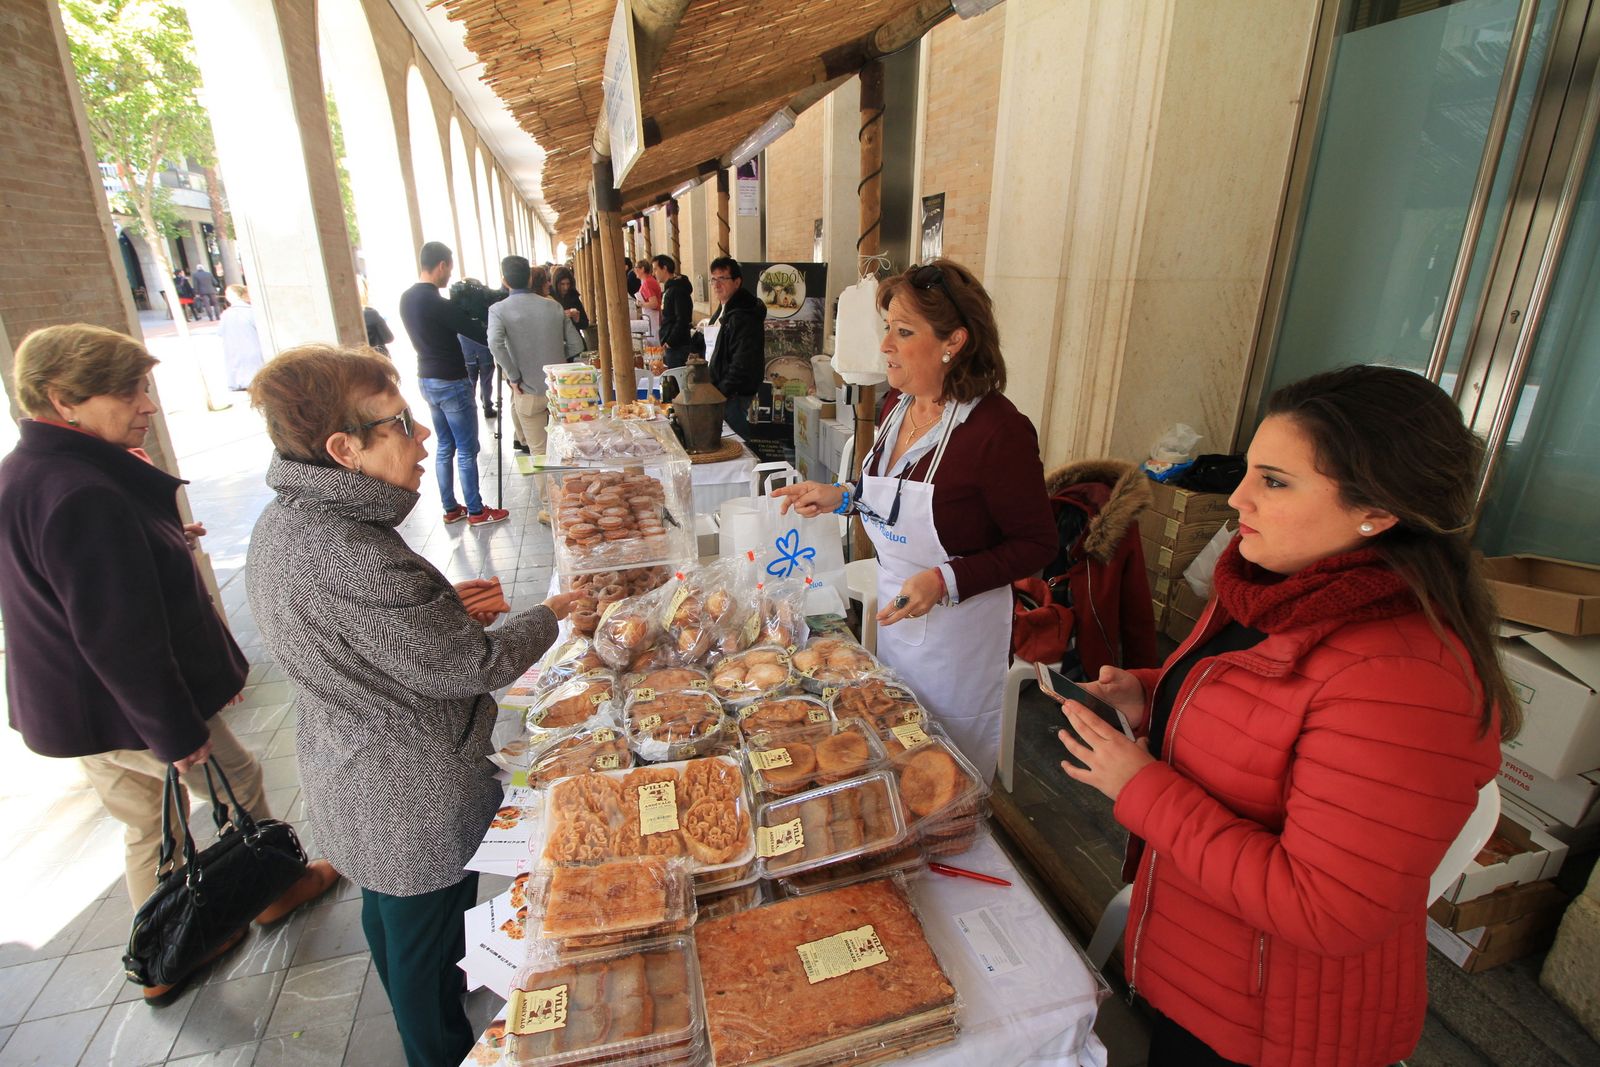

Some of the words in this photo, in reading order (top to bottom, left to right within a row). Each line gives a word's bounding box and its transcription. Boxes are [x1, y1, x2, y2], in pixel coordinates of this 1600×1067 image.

[758, 269, 807, 284] CANDÓN
[1505, 761, 1535, 781] FRITOS
[642, 783, 670, 791] VILLA
[1503, 772, 1531, 792] FRITAS
[793, 822, 801, 845] VILLA
[843, 939, 857, 963] HORNAZO
[870, 932, 884, 955] VILLA
[553, 991, 563, 1023] VILLA
